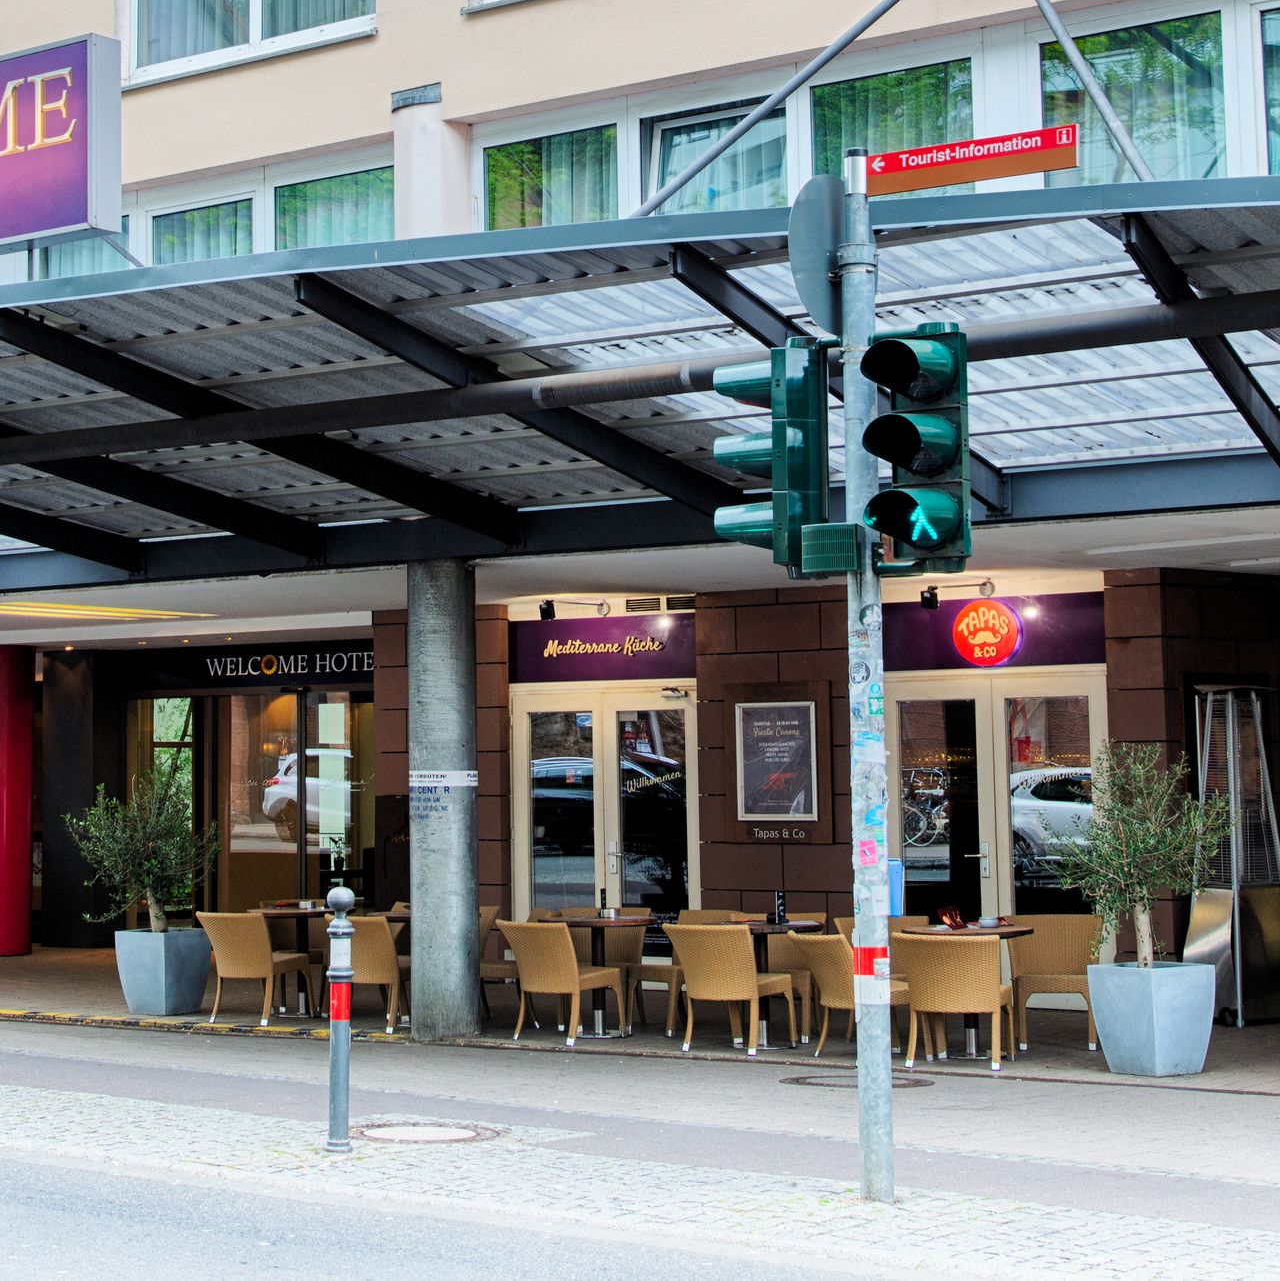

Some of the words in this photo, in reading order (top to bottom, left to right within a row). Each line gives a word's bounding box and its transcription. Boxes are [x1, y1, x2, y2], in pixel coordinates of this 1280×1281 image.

[898, 135, 1042, 168] Tourist-Information
[958, 607, 1010, 636] TAPAS
[543, 639, 622, 658] Mediterrane
[623, 635, 664, 656] Küche
[974, 646, 983, 657] &
[984, 646, 997, 657] CO
[206, 653, 309, 677] WELCOME
[624, 770, 683, 794] Willkommen
[753, 828, 779, 840] Tapas
[782, 828, 790, 838] &
[792, 828, 805, 838] Co
